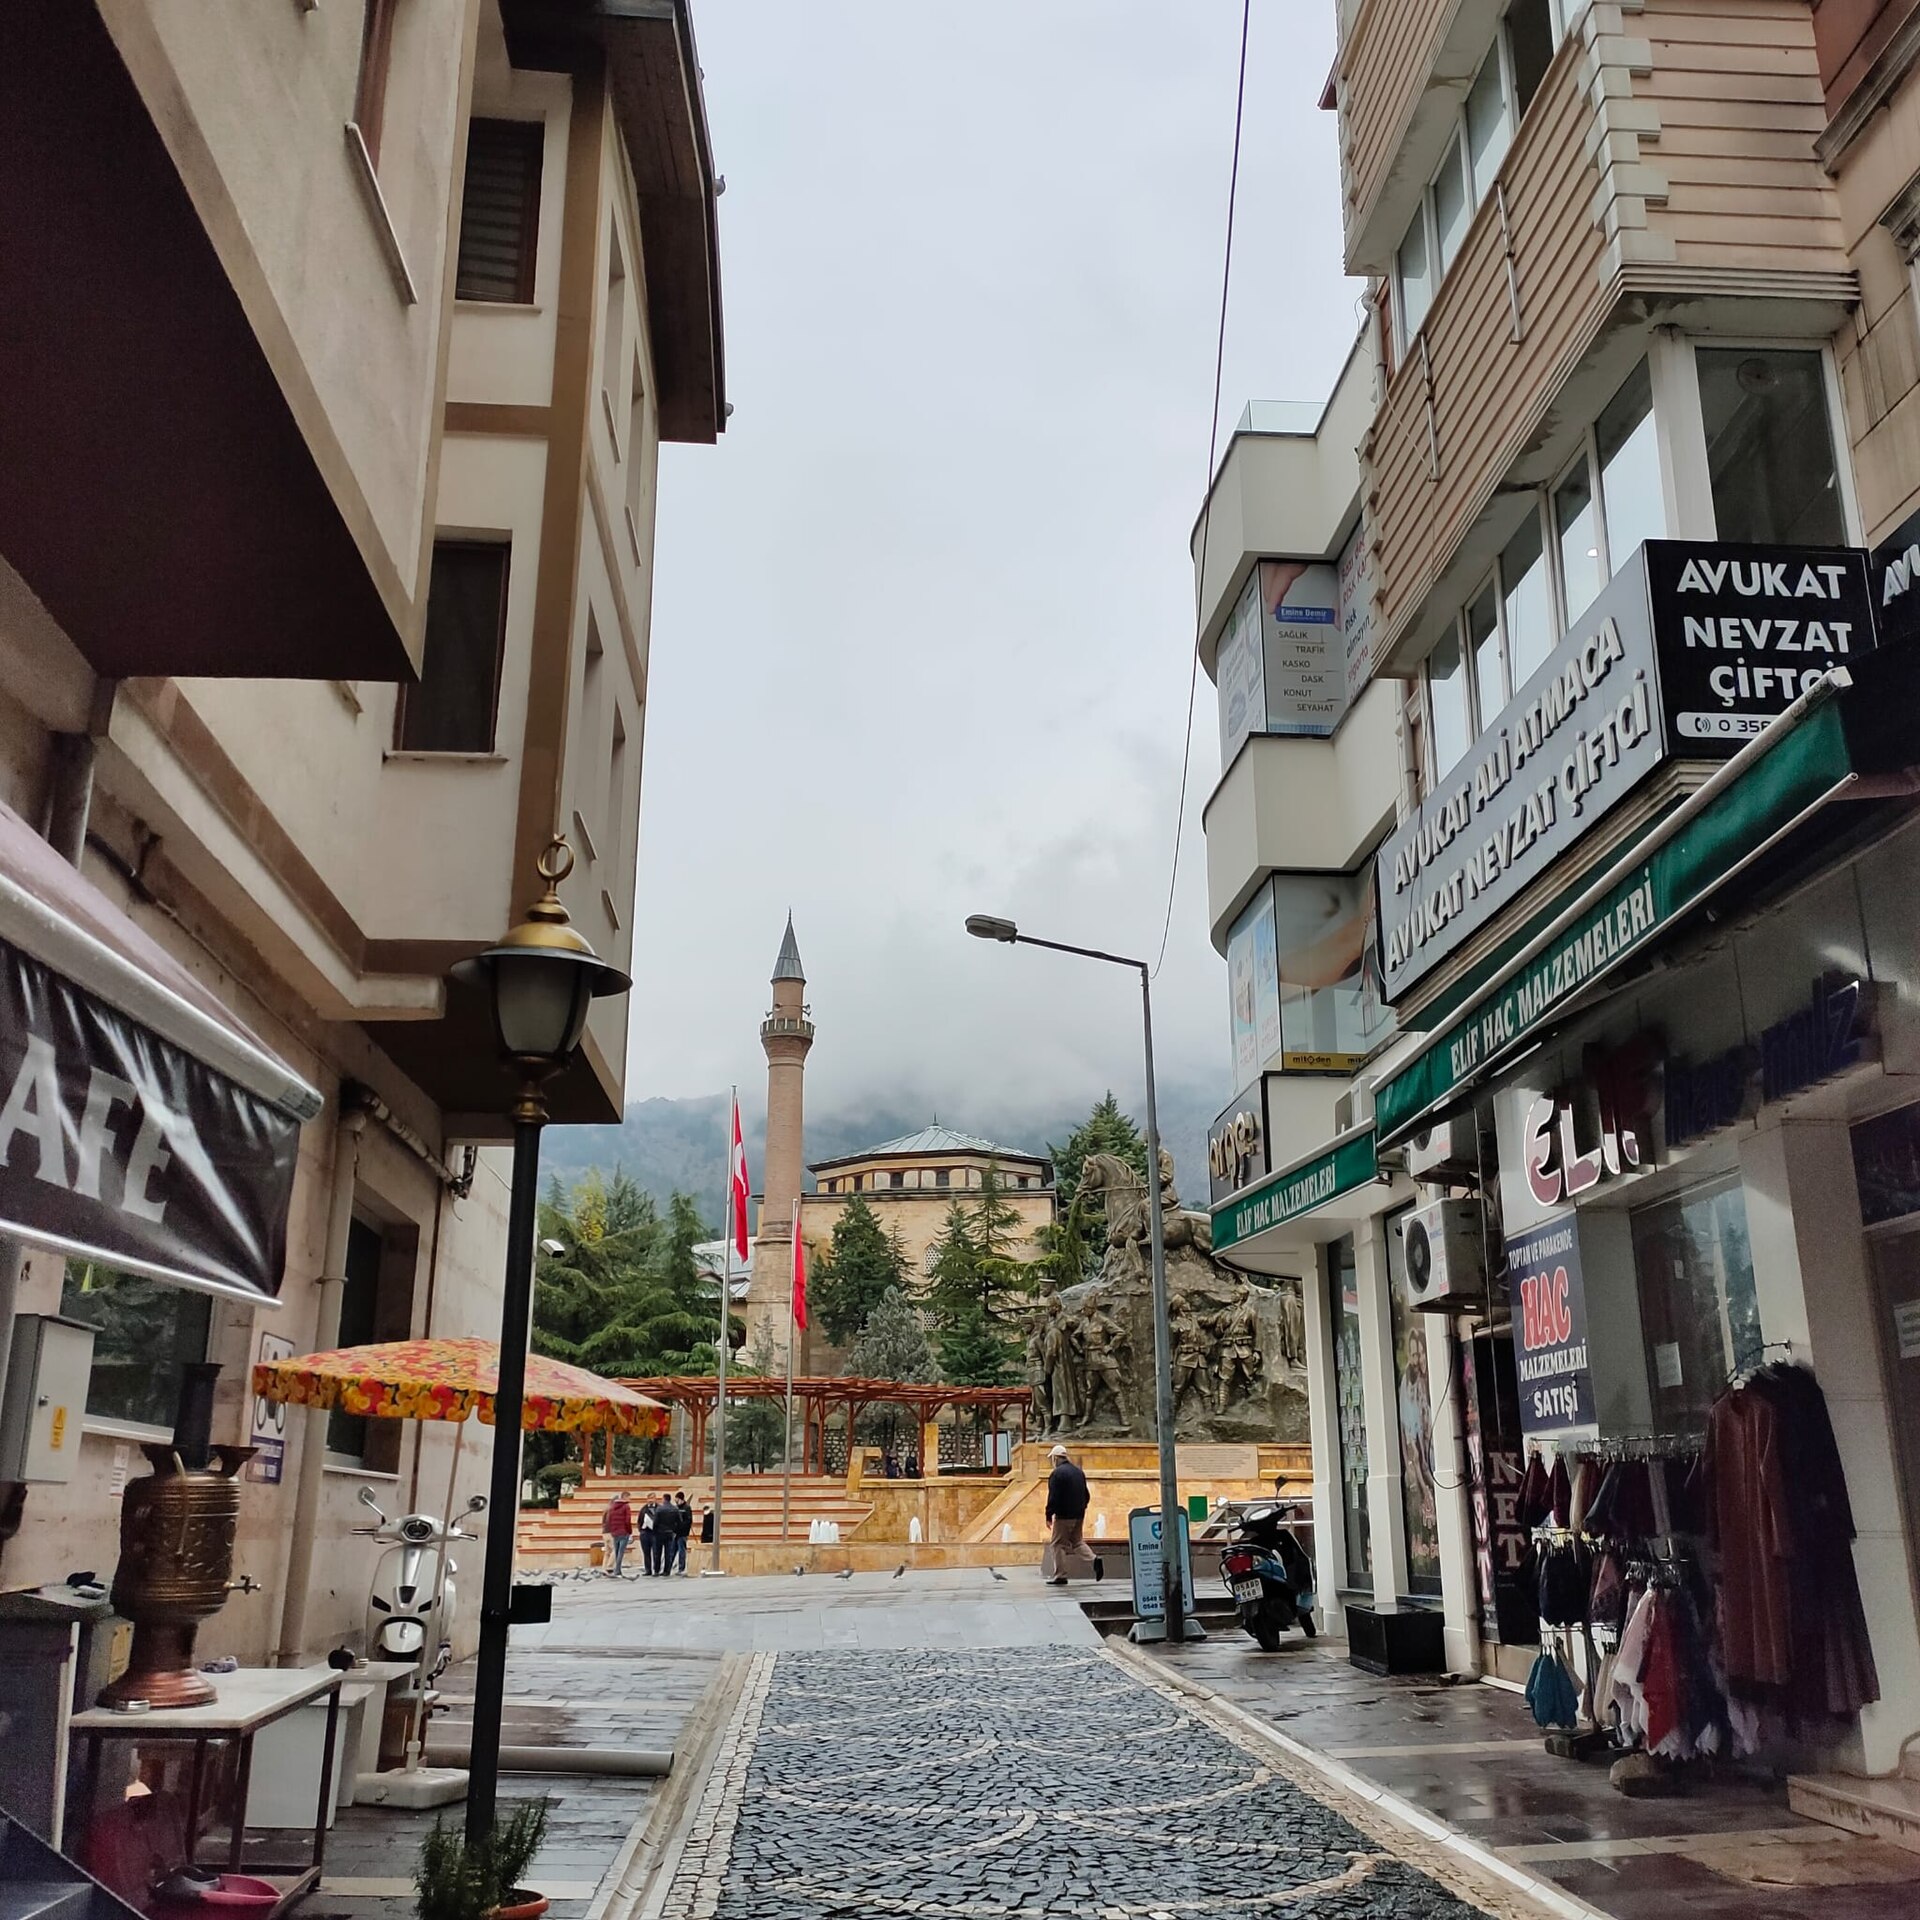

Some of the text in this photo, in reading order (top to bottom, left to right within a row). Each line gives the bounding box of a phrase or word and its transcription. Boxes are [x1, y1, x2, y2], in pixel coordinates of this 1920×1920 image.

[1677, 558, 1846, 599] AVUKAT
[1278, 629, 1308, 639] SAĞLIK
[1683, 616, 1852, 653] NEVZAT
[1282, 660, 1310, 668] KASKO
[1302, 675, 1324, 683] DASK
[1283, 688, 1312, 697] KONUT
[1297, 703, 1334, 712] SEYAHAT
[1394, 616, 1625, 894] AVUKAT ALİ ATMACA
[1389, 869, 1464, 972] AVUKAT
[1467, 775, 1557, 900] NEVZAT
[1450, 867, 1655, 1081] ELİF HAC MALZEMELERİ
[0, 1031, 170, 1224] AFE
[1236, 1154, 1336, 1238] ELİF HAC MALZEMELERİ
[1509, 1244, 1531, 1271] TOPTAN
[1531, 1242, 1538, 1261] VE
[1520, 1265, 1571, 1351] HAC
[1520, 1338, 1587, 1382] MALZEMELERİ
